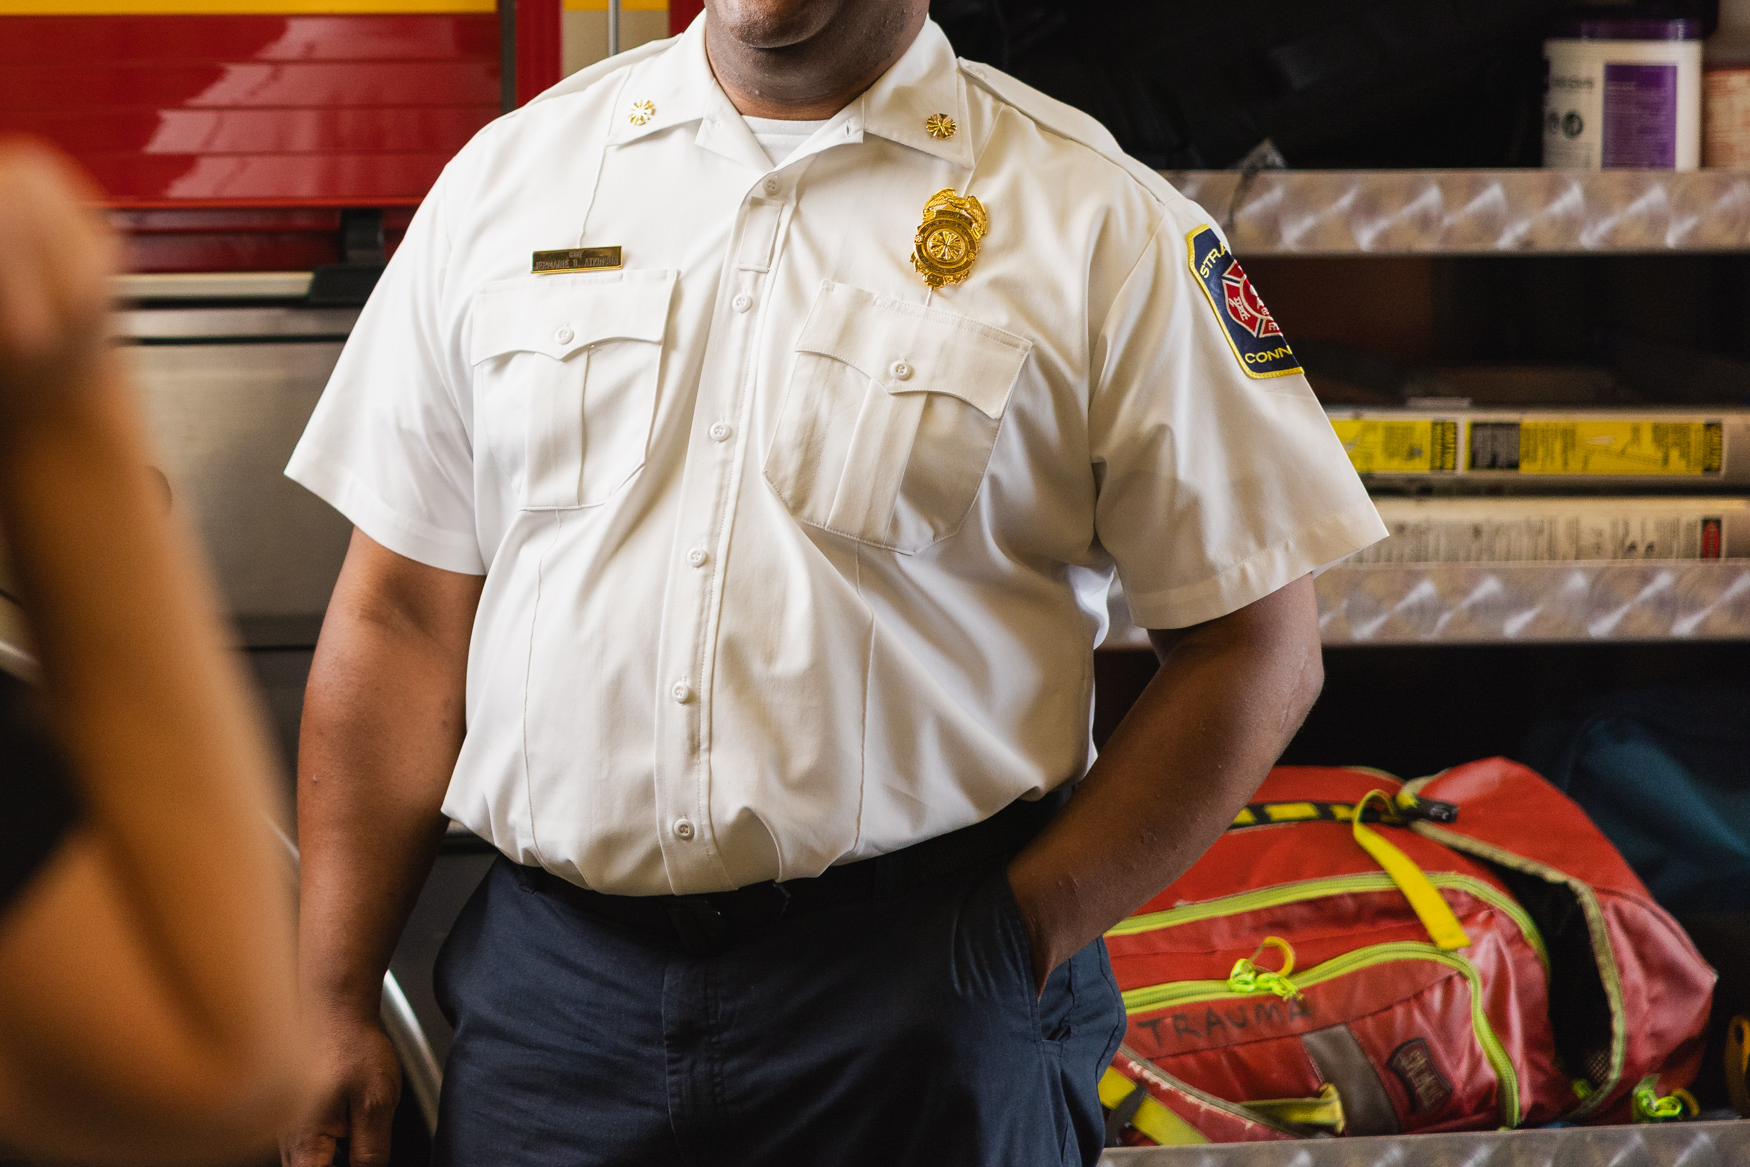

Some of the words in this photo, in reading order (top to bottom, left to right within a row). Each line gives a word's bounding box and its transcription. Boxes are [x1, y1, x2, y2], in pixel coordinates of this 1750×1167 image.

[1199, 241, 1227, 279] STRA
[1244, 344, 1293, 364] CONN
[1137, 997, 1312, 1048] TRAUMA
